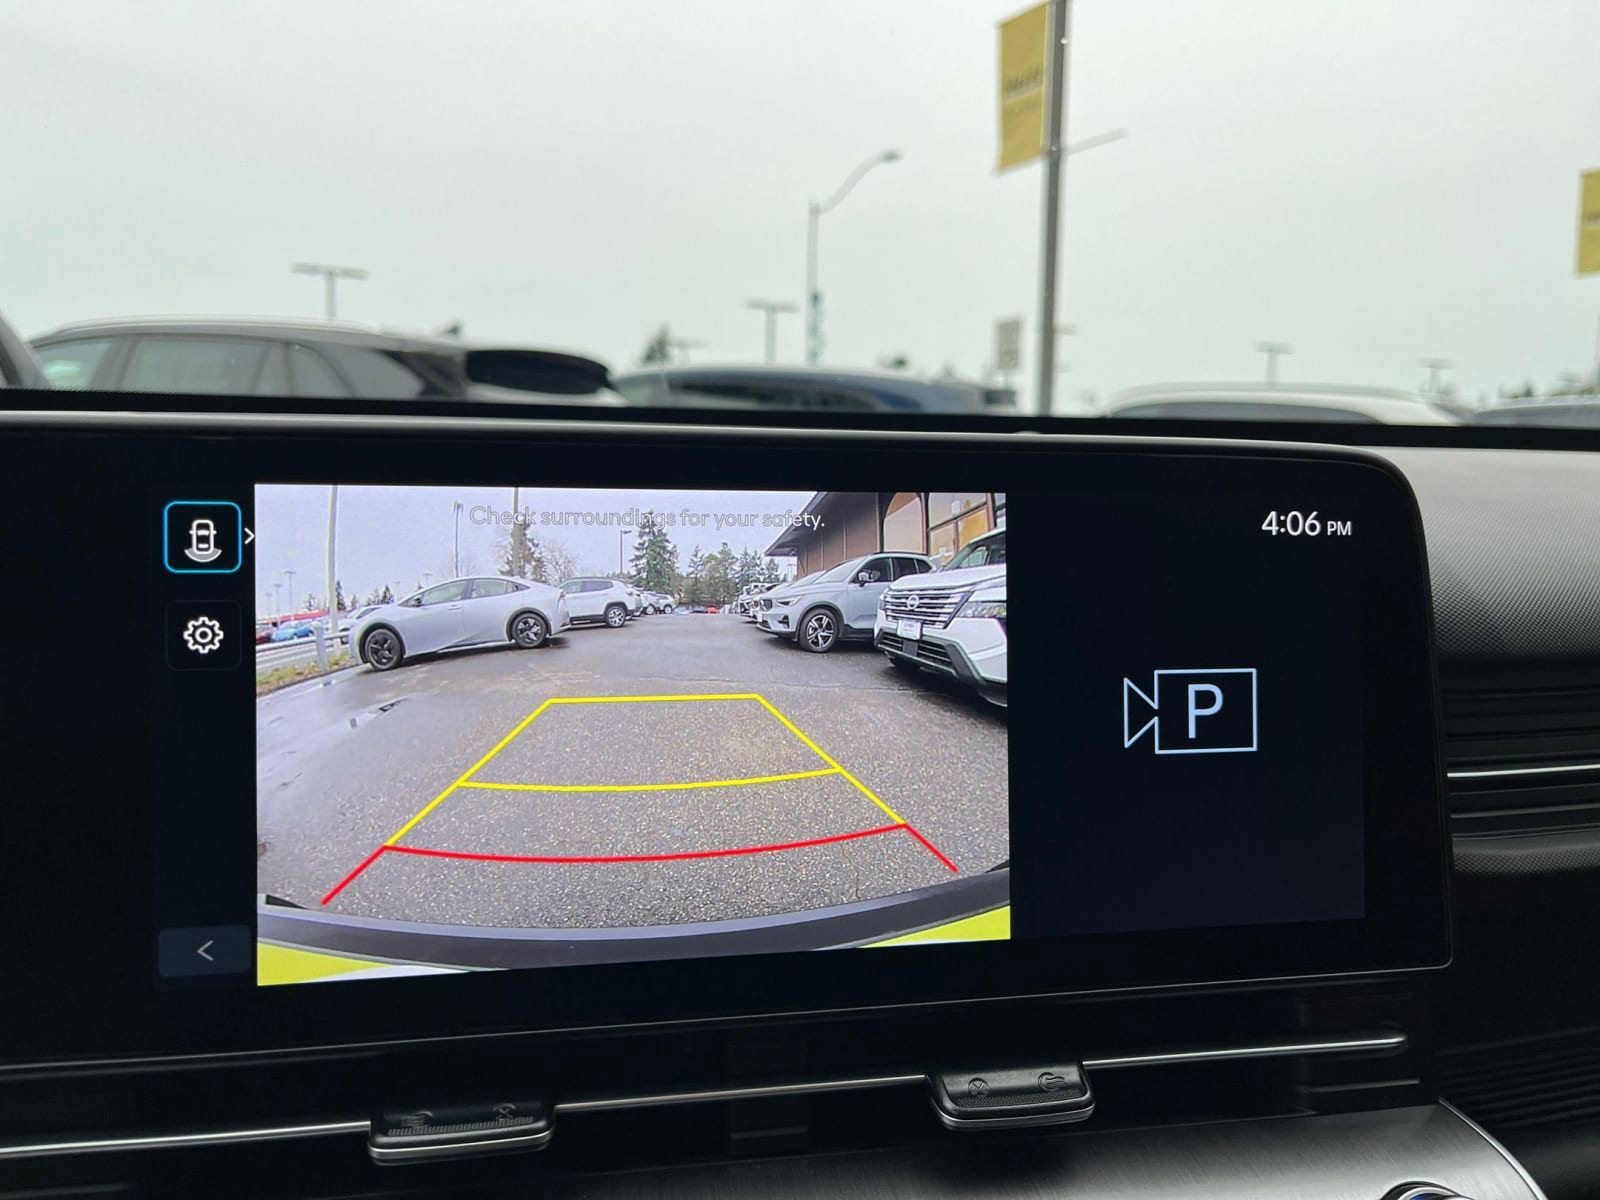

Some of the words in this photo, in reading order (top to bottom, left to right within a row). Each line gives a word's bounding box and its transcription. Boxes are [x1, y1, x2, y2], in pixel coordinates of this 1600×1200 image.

[469, 505, 537, 526] Check
[540, 507, 676, 530] surroundings
[679, 508, 710, 527] for
[713, 512, 759, 531] your
[762, 509, 825, 531] safety.
[1261, 510, 1321, 536] 4:06
[1327, 520, 1352, 536] PM
[1187, 683, 1223, 739] P
